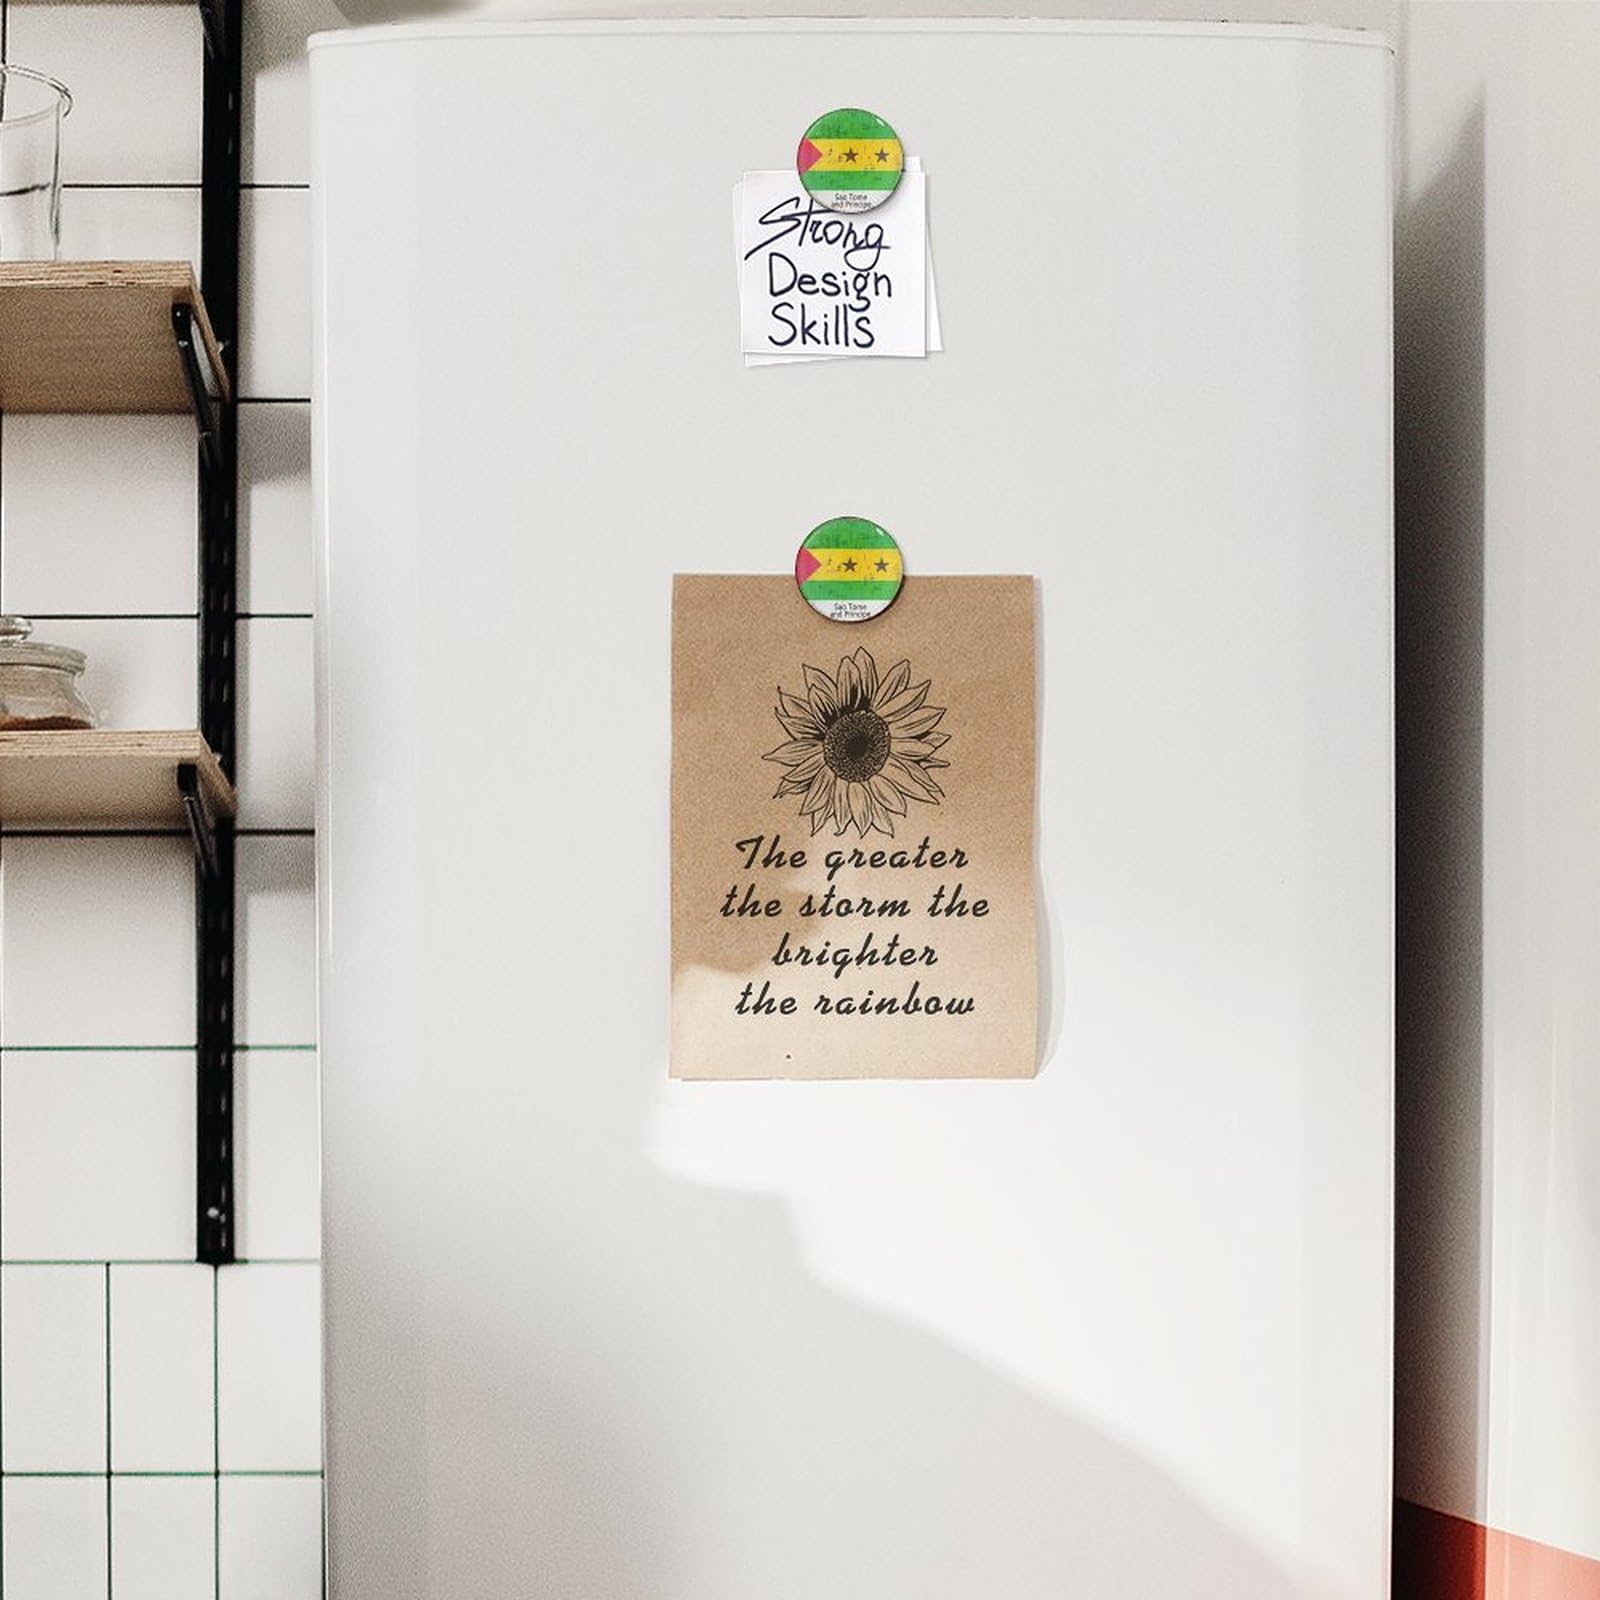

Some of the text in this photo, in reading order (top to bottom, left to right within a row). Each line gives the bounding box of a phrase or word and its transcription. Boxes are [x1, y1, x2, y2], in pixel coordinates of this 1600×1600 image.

[744, 197, 891, 272] Strong
[768, 252, 892, 312] Design
[768, 302, 875, 348] Skills
[735, 835, 969, 881] The greater
[719, 883, 990, 918] the storm the
[771, 932, 938, 979] brighter
[735, 980, 975, 1016] the rainbow
